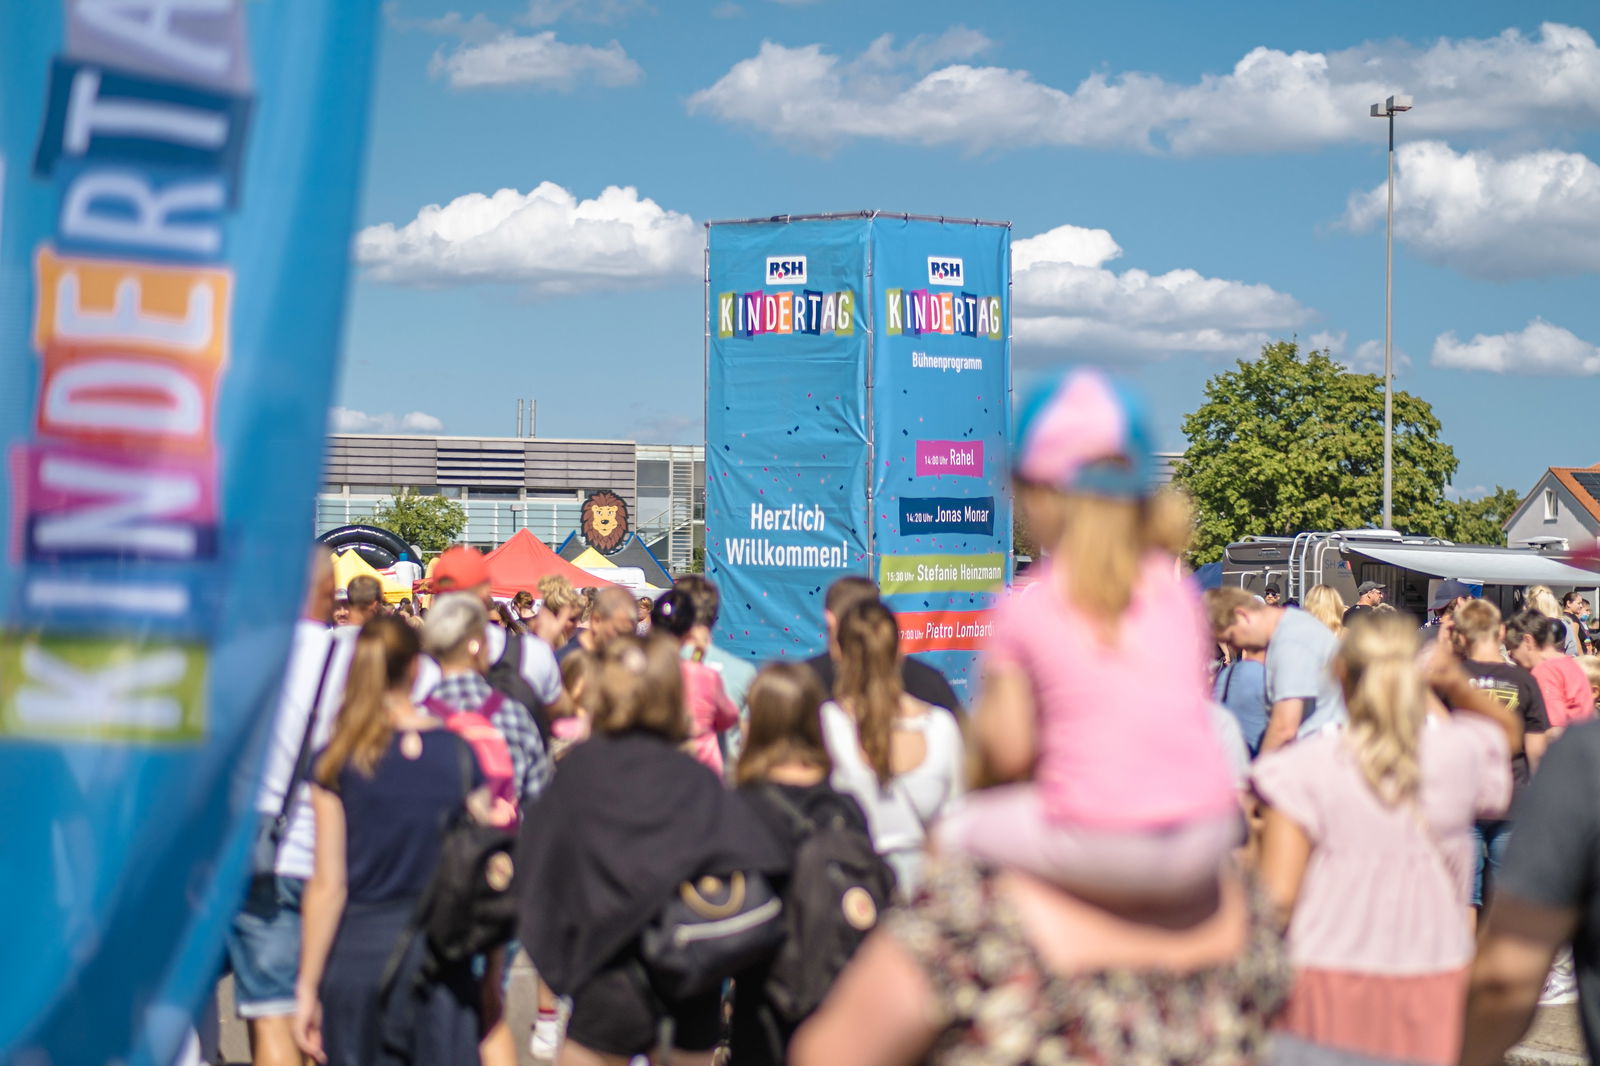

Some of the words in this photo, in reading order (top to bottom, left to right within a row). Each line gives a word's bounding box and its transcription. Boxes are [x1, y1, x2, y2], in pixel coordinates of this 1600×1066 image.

[770, 261, 803, 276] RSH
[931, 261, 960, 277] RSH
[720, 294, 850, 333] KINDERTAG
[888, 293, 1000, 334] KINDERTAG
[912, 352, 983, 373] Bühnenprogramm
[924, 455, 938, 465] 14:00
[939, 456, 948, 465] Uhr
[950, 448, 974, 466] Rahel
[750, 503, 825, 532] Herzlich
[906, 512, 922, 523] 14:20
[923, 513, 933, 522] Uhr
[935, 505, 961, 523] Jonas
[964, 505, 989, 523] Monar
[725, 538, 848, 568] Willkommen!
[887, 571, 904, 582] 15:30
[904, 571, 914, 581] Uhr
[917, 563, 957, 581] Stefanie
[960, 563, 1002, 580] Heinzmann
[899, 630, 914, 640] 7:00
[914, 630, 924, 640] Uhr
[926, 622, 953, 639] Pietro
